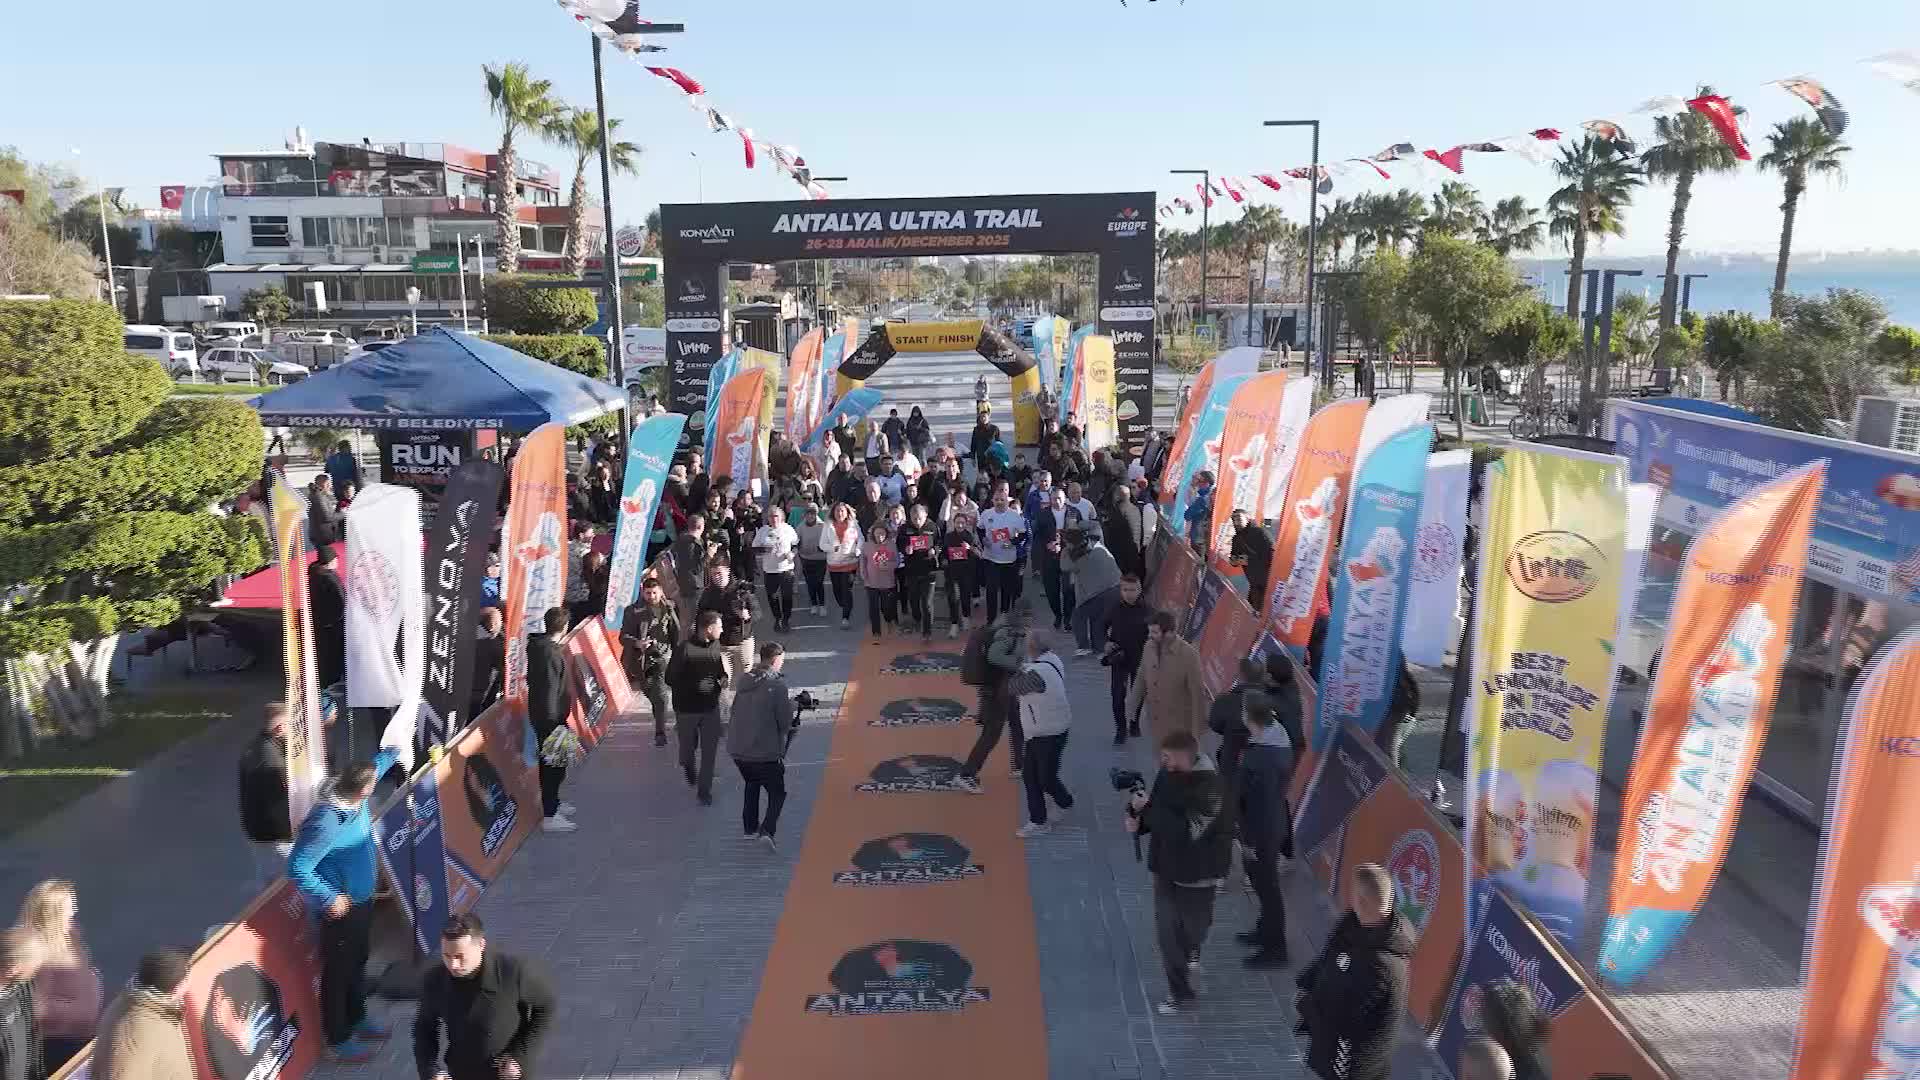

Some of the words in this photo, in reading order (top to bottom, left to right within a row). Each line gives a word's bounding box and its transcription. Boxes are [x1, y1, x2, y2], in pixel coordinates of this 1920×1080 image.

[772, 211, 883, 233] ANTALYA
[889, 209, 967, 231] ULTRA
[973, 208, 1043, 229] TRAIL
[1107, 220, 1148, 232] EUROPE
[806, 238, 844, 250] 26-28
[975, 234, 1010, 247] 2025
[895, 336, 929, 345] START
[938, 334, 975, 344] FINISH
[287, 416, 393, 428] KONYAALTI
[391, 443, 461, 468] RUN
[392, 466, 408, 475] TO
[429, 499, 472, 691] ZENOVA
[1867, 575, 1885, 591] 153
[1343, 586, 1376, 716] ANTALYA
[1512, 652, 1570, 677] BEST
[1483, 672, 1600, 712] LEMONADE
[1504, 692, 1526, 711] IN
[1533, 694, 1574, 722] THE
[482, 802, 516, 856] ANTALYA
[838, 866, 983, 883] ANTALYA
[808, 988, 987, 1011] ANTALYA
